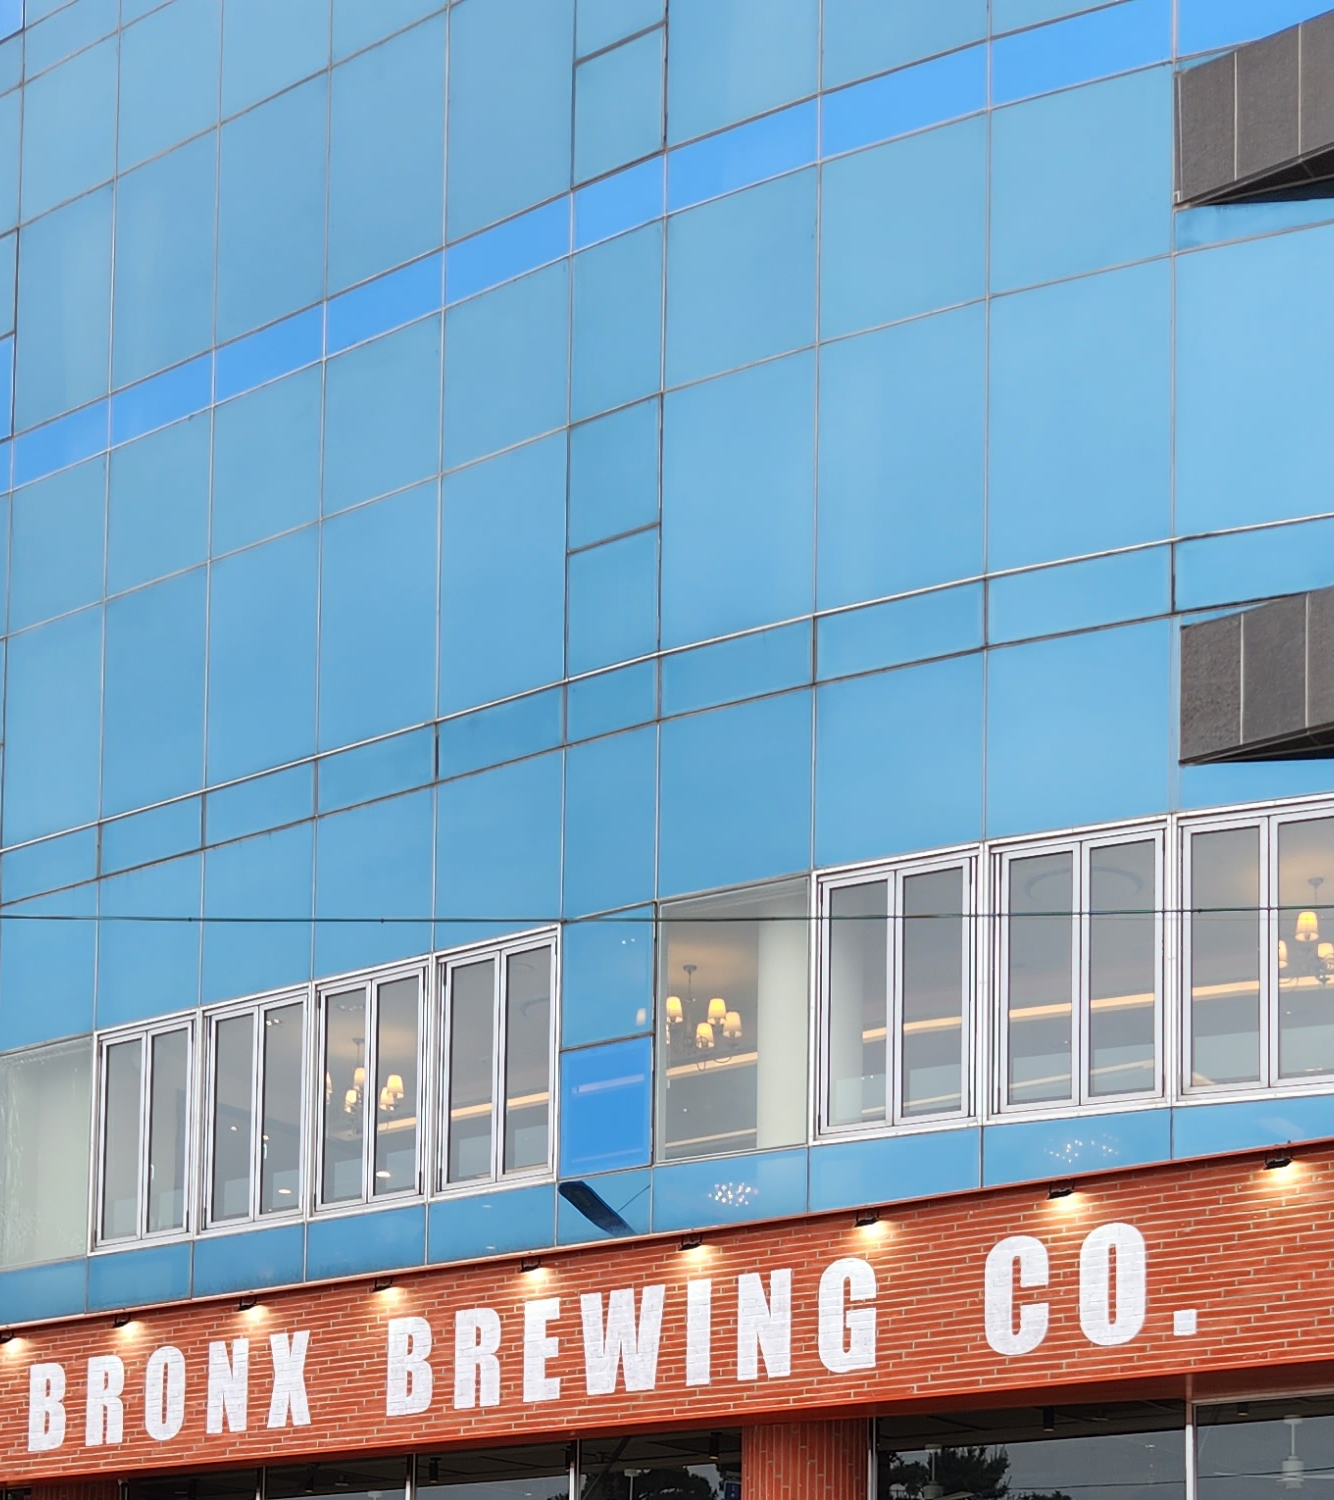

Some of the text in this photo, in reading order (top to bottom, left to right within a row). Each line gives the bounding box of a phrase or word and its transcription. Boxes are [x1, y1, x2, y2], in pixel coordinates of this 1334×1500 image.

[28, 1222, 1198, 1453] BRONX BREWING CO.
